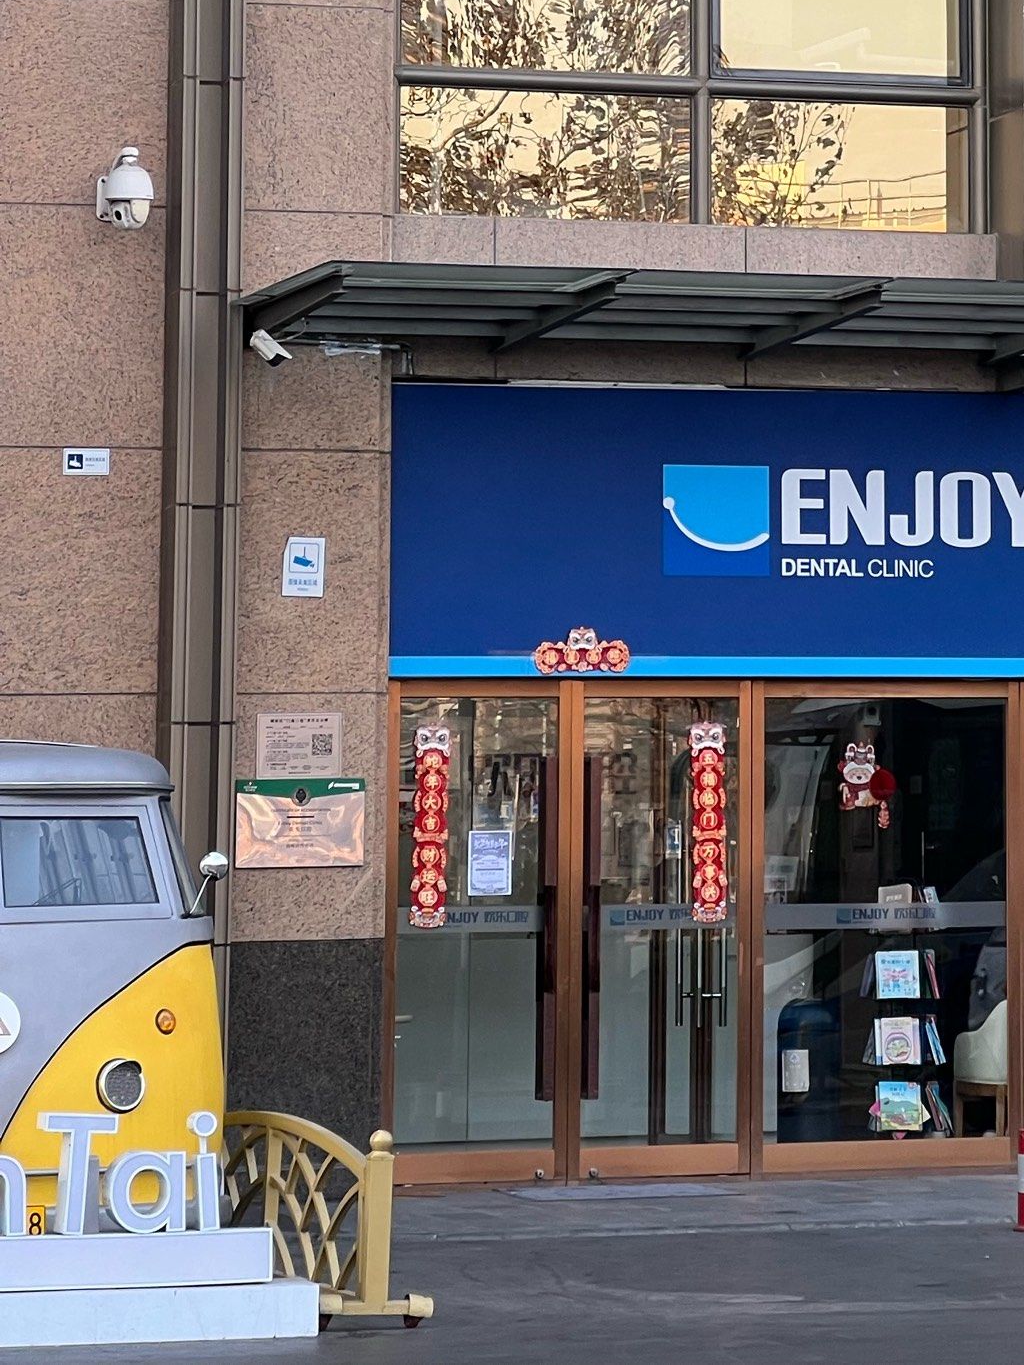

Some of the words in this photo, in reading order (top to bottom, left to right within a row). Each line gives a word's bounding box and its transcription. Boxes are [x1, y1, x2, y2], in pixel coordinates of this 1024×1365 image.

[781, 558, 863, 577] DENTAL
[867, 558, 934, 578] CLINIC
[447, 911, 479, 923] NJOY
[626, 909, 664, 921] ENJOY
[852, 908, 889, 919] ENJOY
